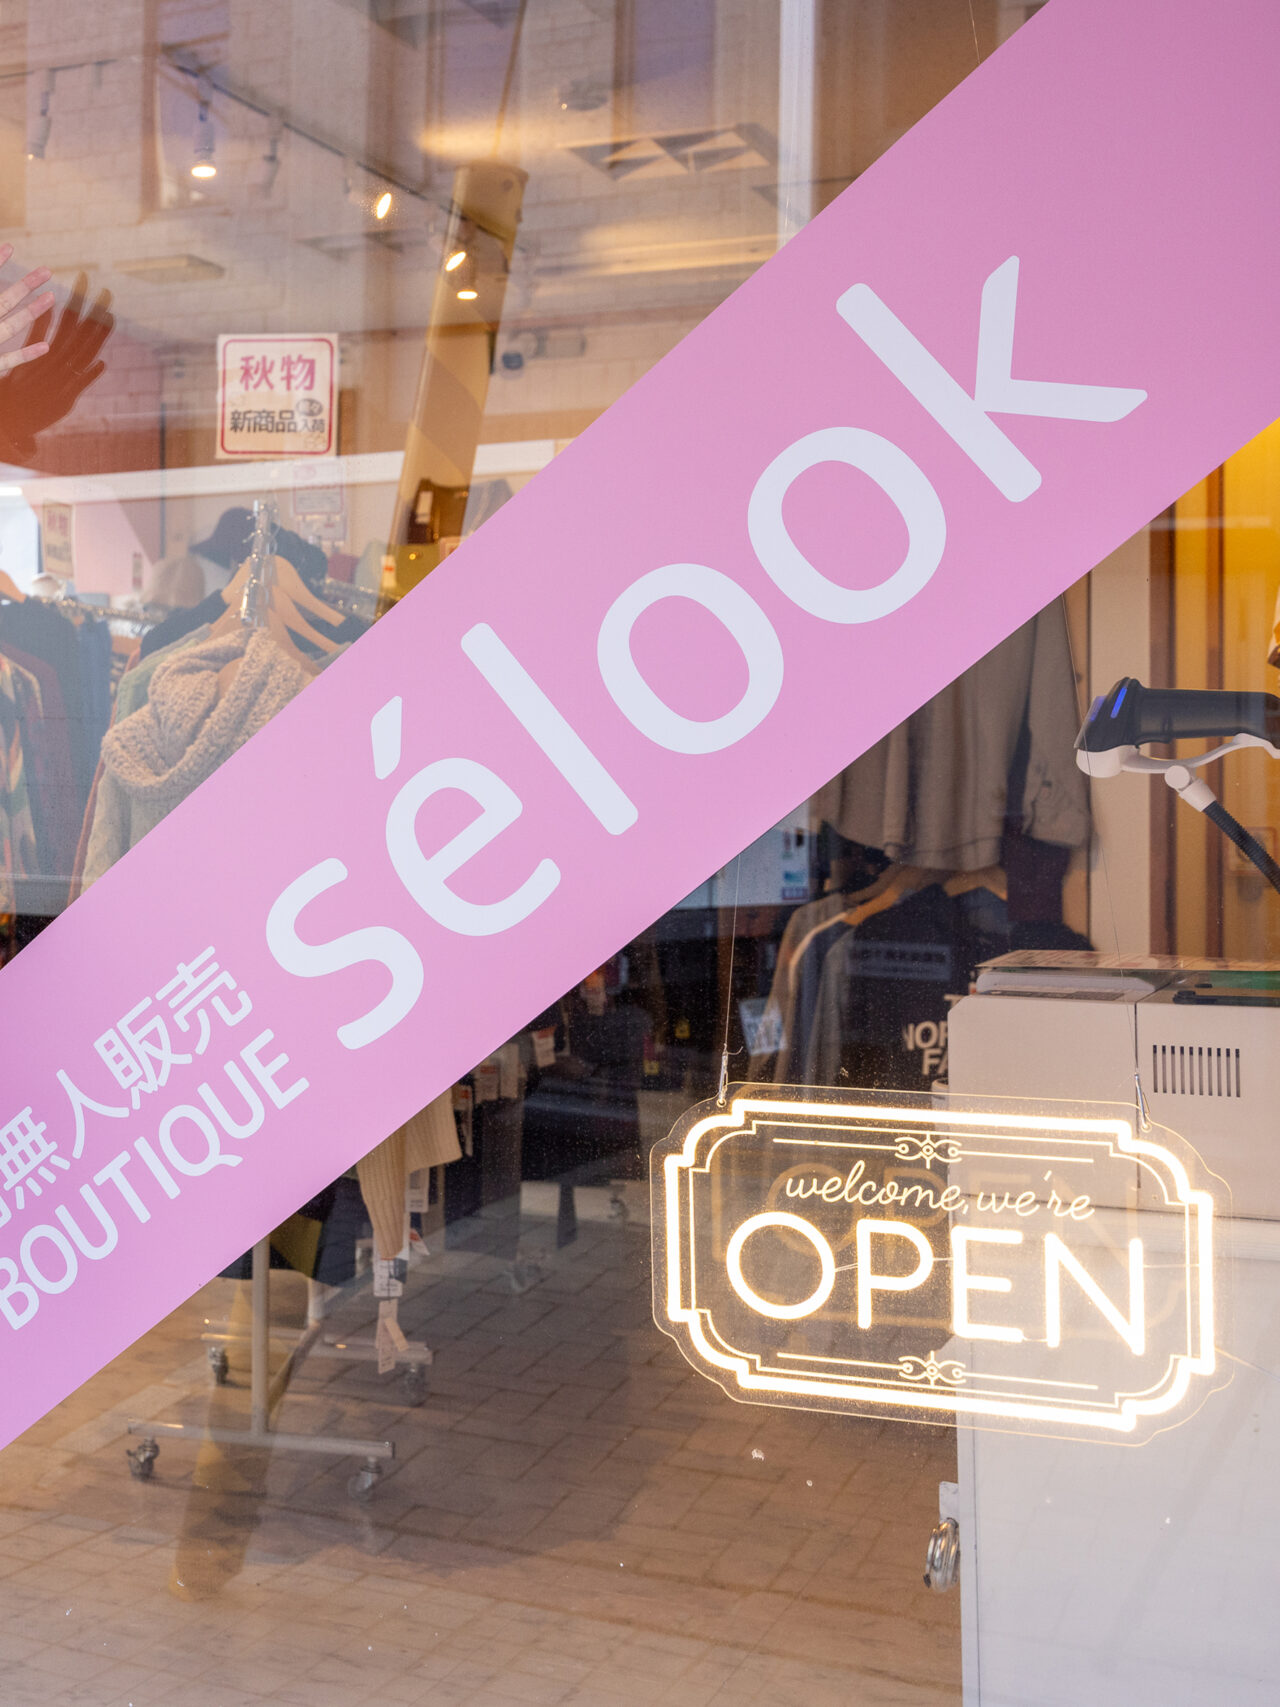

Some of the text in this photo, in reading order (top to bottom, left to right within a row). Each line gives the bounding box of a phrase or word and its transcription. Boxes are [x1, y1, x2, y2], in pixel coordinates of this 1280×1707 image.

[240, 354, 316, 391] 秋物
[265, 255, 1148, 1052] sélook
[725, 1210, 1146, 1357] OPEN
